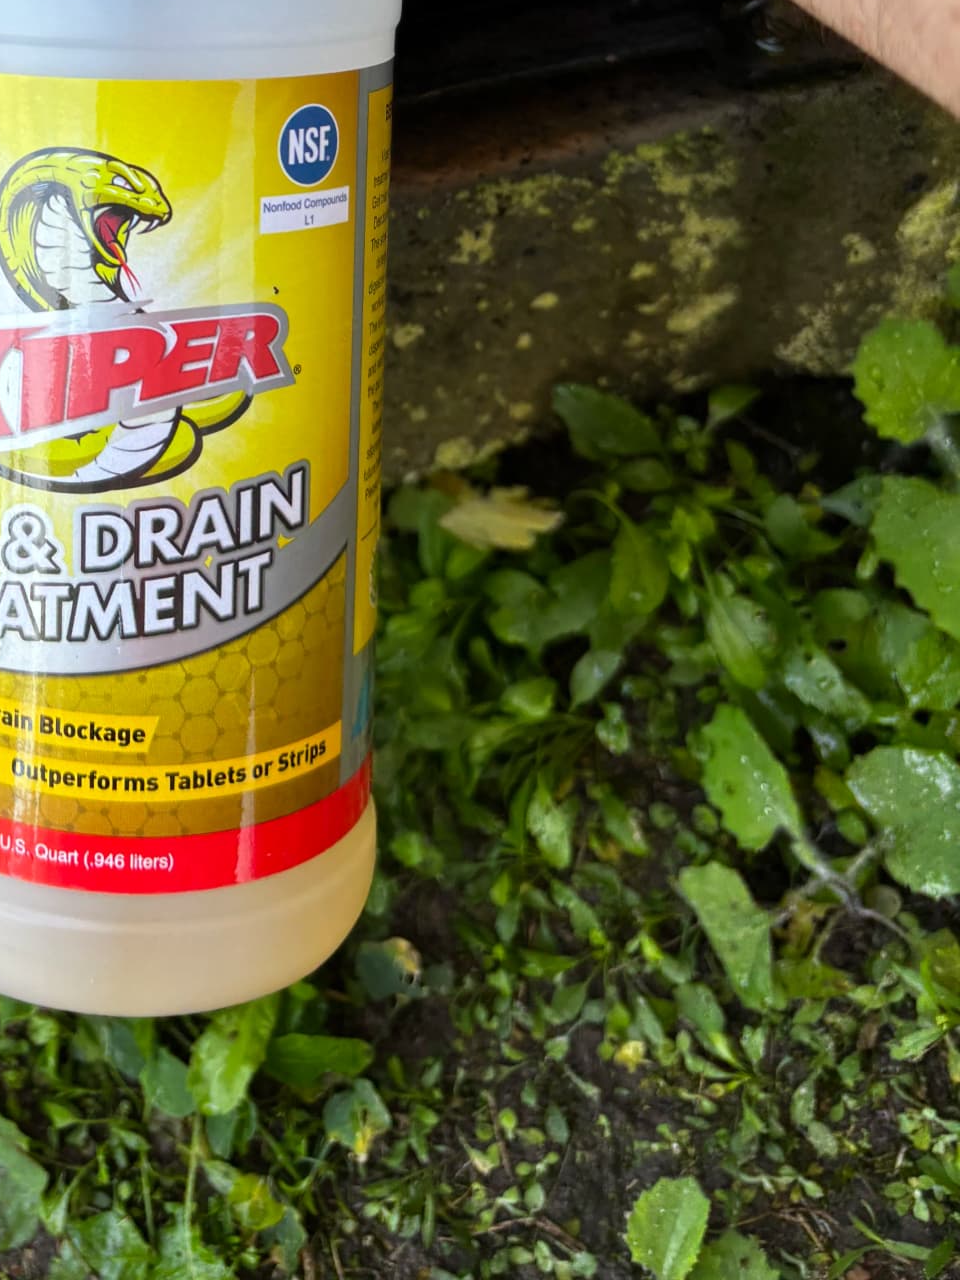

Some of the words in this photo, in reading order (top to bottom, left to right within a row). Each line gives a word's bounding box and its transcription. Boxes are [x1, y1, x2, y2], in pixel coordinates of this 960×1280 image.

[288, 125, 331, 165] NSF
[263, 200, 302, 213] Nonfood
[304, 192, 348, 209] Compounds
[1, 510, 61, 574] &
[80, 467, 306, 573] DRAIN
[40, 715, 147, 747] Blockage
[11, 758, 159, 793] Outperforms
[165, 767, 247, 792] Tablets
[253, 760, 273, 779] or
[278, 740, 327, 771] Strips
[0, 833, 30, 856] U.S.
[35, 843, 79, 865] Quart
[83, 852, 125, 870] (.946
[129, 852, 175, 872] liters)
